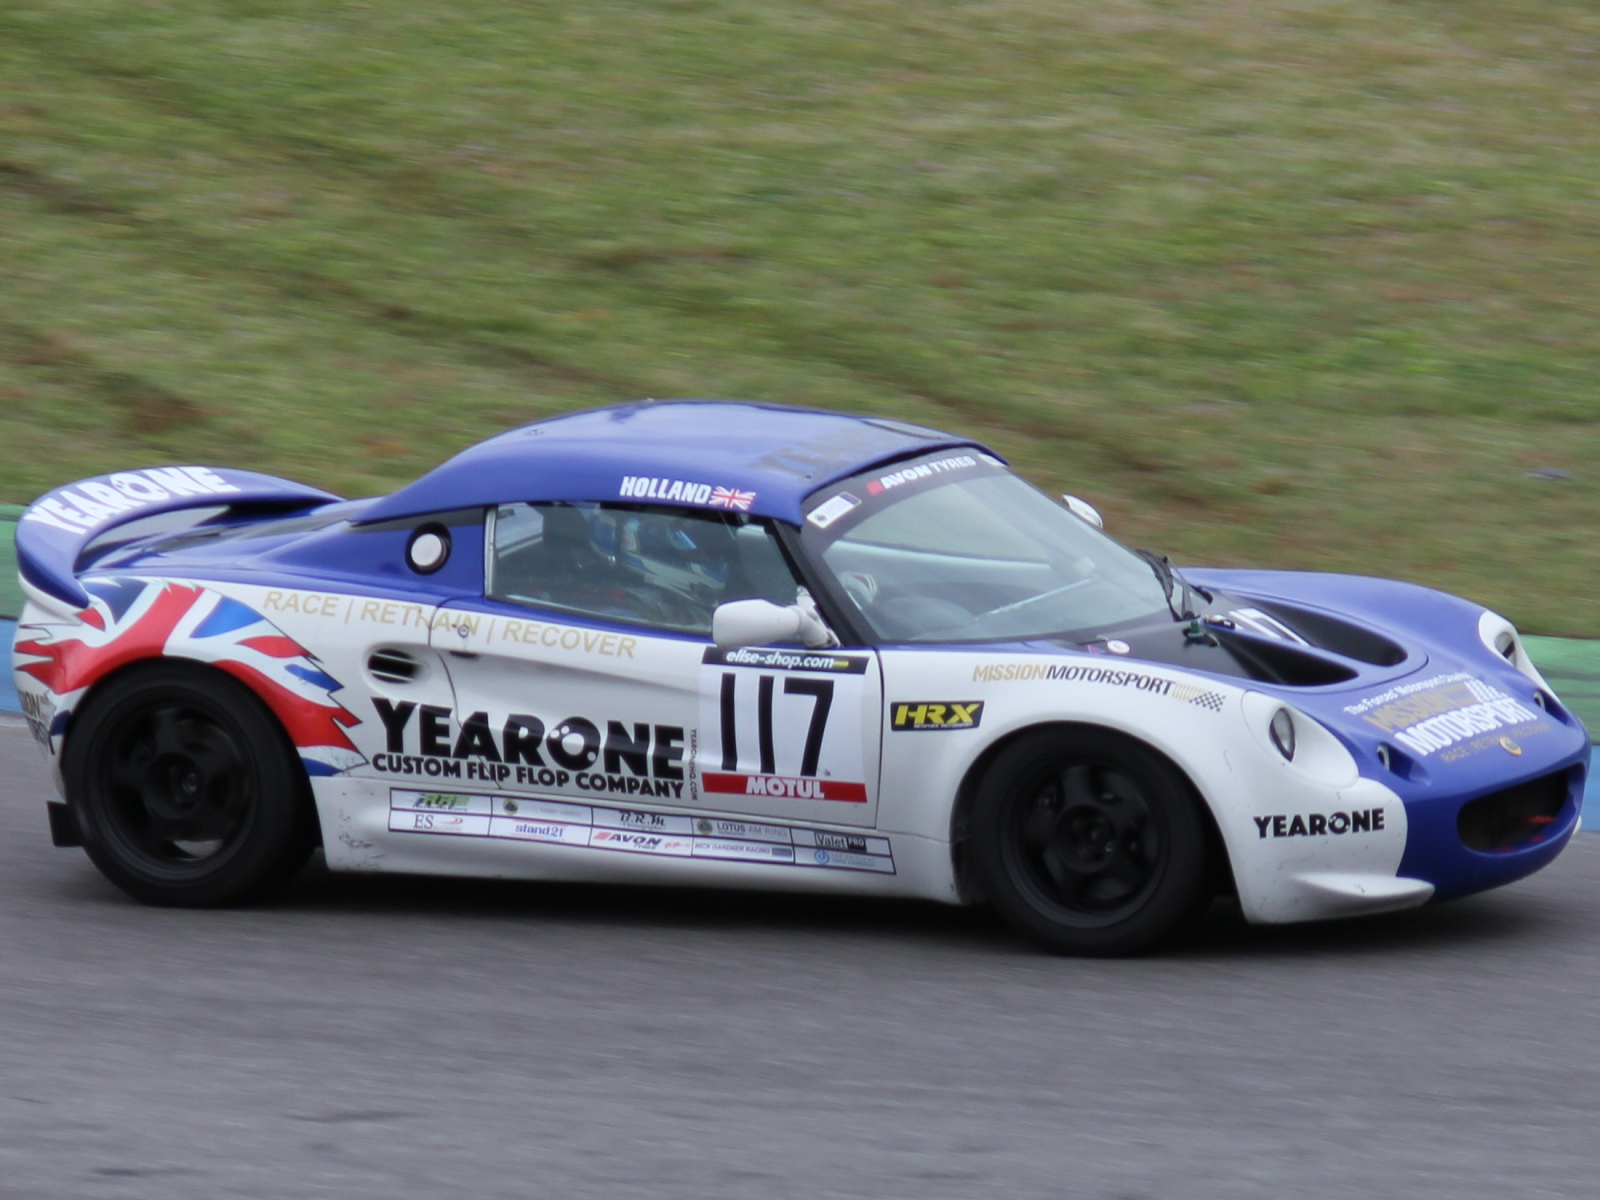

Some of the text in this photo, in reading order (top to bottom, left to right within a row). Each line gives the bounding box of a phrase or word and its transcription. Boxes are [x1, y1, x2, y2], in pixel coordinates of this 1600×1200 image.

[879, 455, 977, 489] AVON TYRES
[23, 466, 242, 534] YEARONE
[619, 476, 711, 505] HOLLAND
[262, 590, 336, 617] RACE
[502, 620, 638, 659] RECOVER
[726, 649, 834, 669] elise-shop.com
[720, 672, 834, 777] 117
[895, 703, 980, 726] HRX
[1394, 697, 1538, 756] MOTORSPORT
[371, 697, 685, 781] YEARONE
[372, 754, 685, 799] CUSTOM FLIP FLOP COMPANY
[746, 777, 825, 799] MOTUL
[414, 814, 434, 829] ES
[717, 822, 746, 832] LOTUS
[1253, 808, 1385, 839] YEARONE
[608, 833, 663, 845] AVON
[817, 834, 846, 849] Valet
